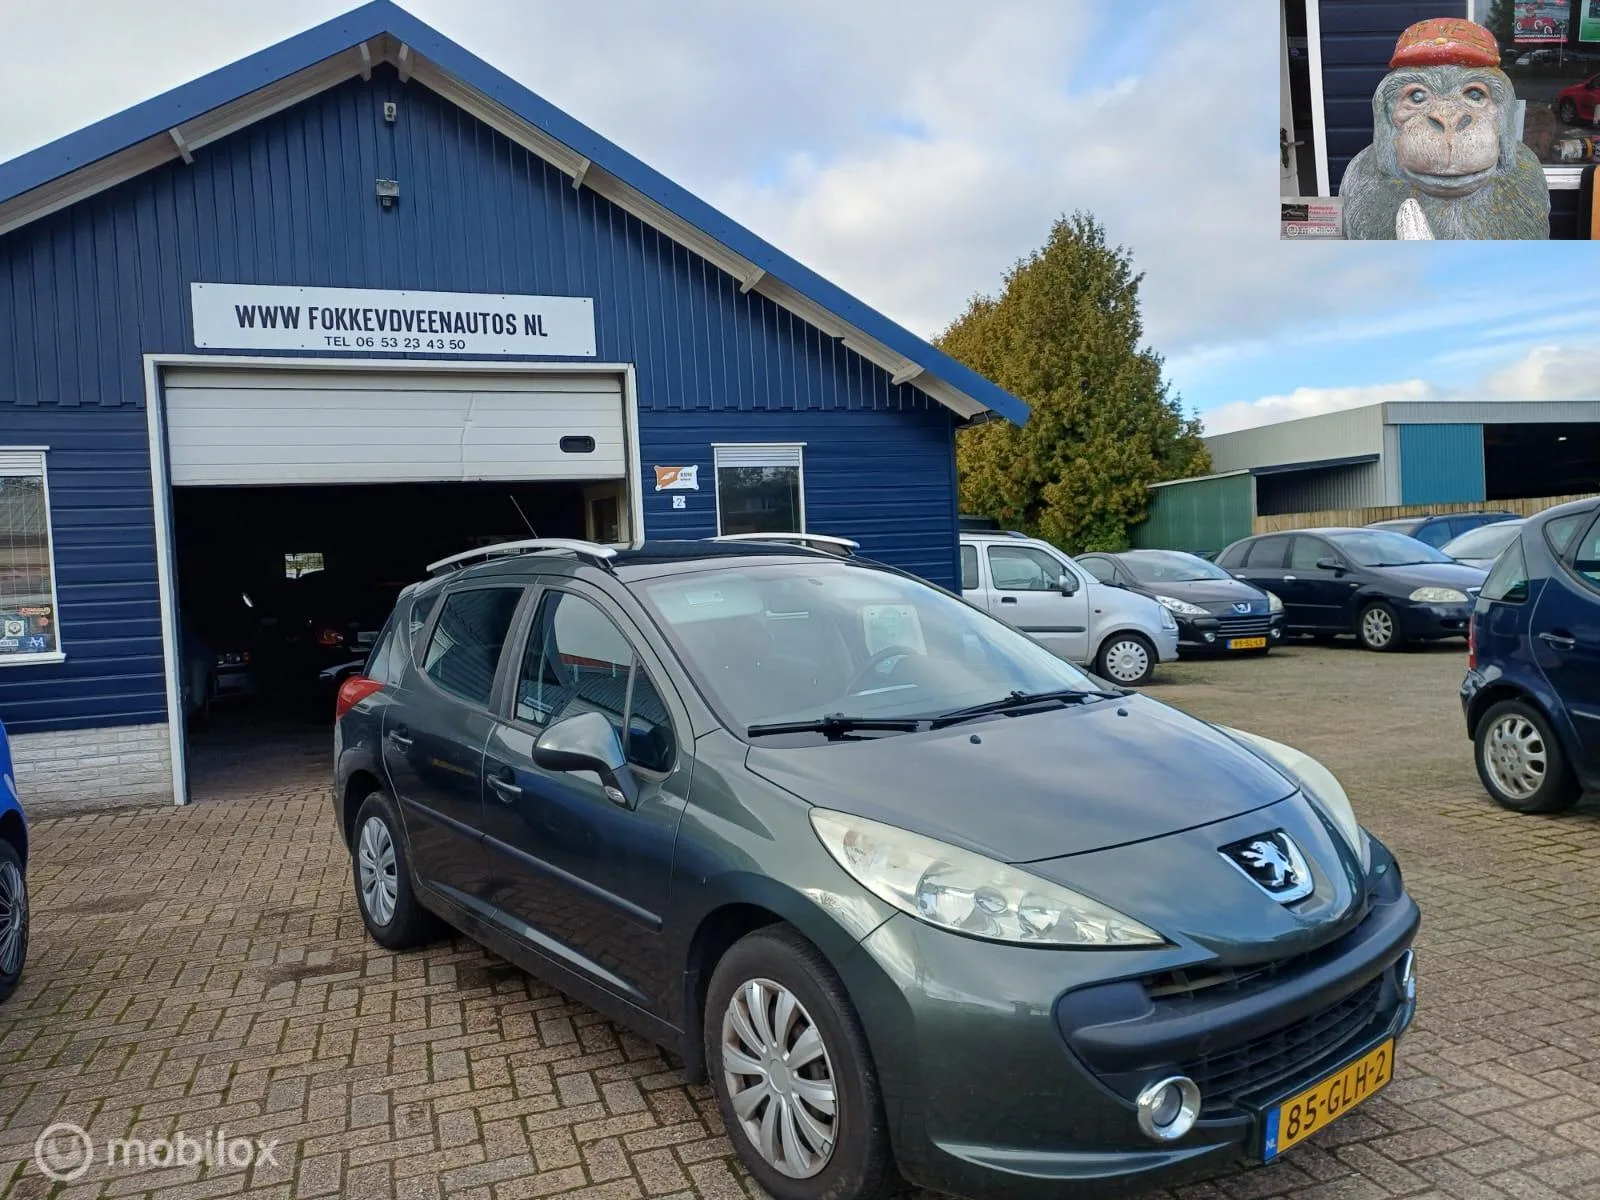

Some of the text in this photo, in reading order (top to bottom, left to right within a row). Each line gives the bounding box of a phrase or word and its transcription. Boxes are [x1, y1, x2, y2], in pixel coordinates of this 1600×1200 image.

[235, 305, 548, 337] WWW FOKKEVDVEENAUTOS NL
[324, 336, 466, 350] TEL 06 53 23 43 50
[676, 497, 682, 507] 2
[1286, 1050, 1386, 1140] 85-GLH-2
